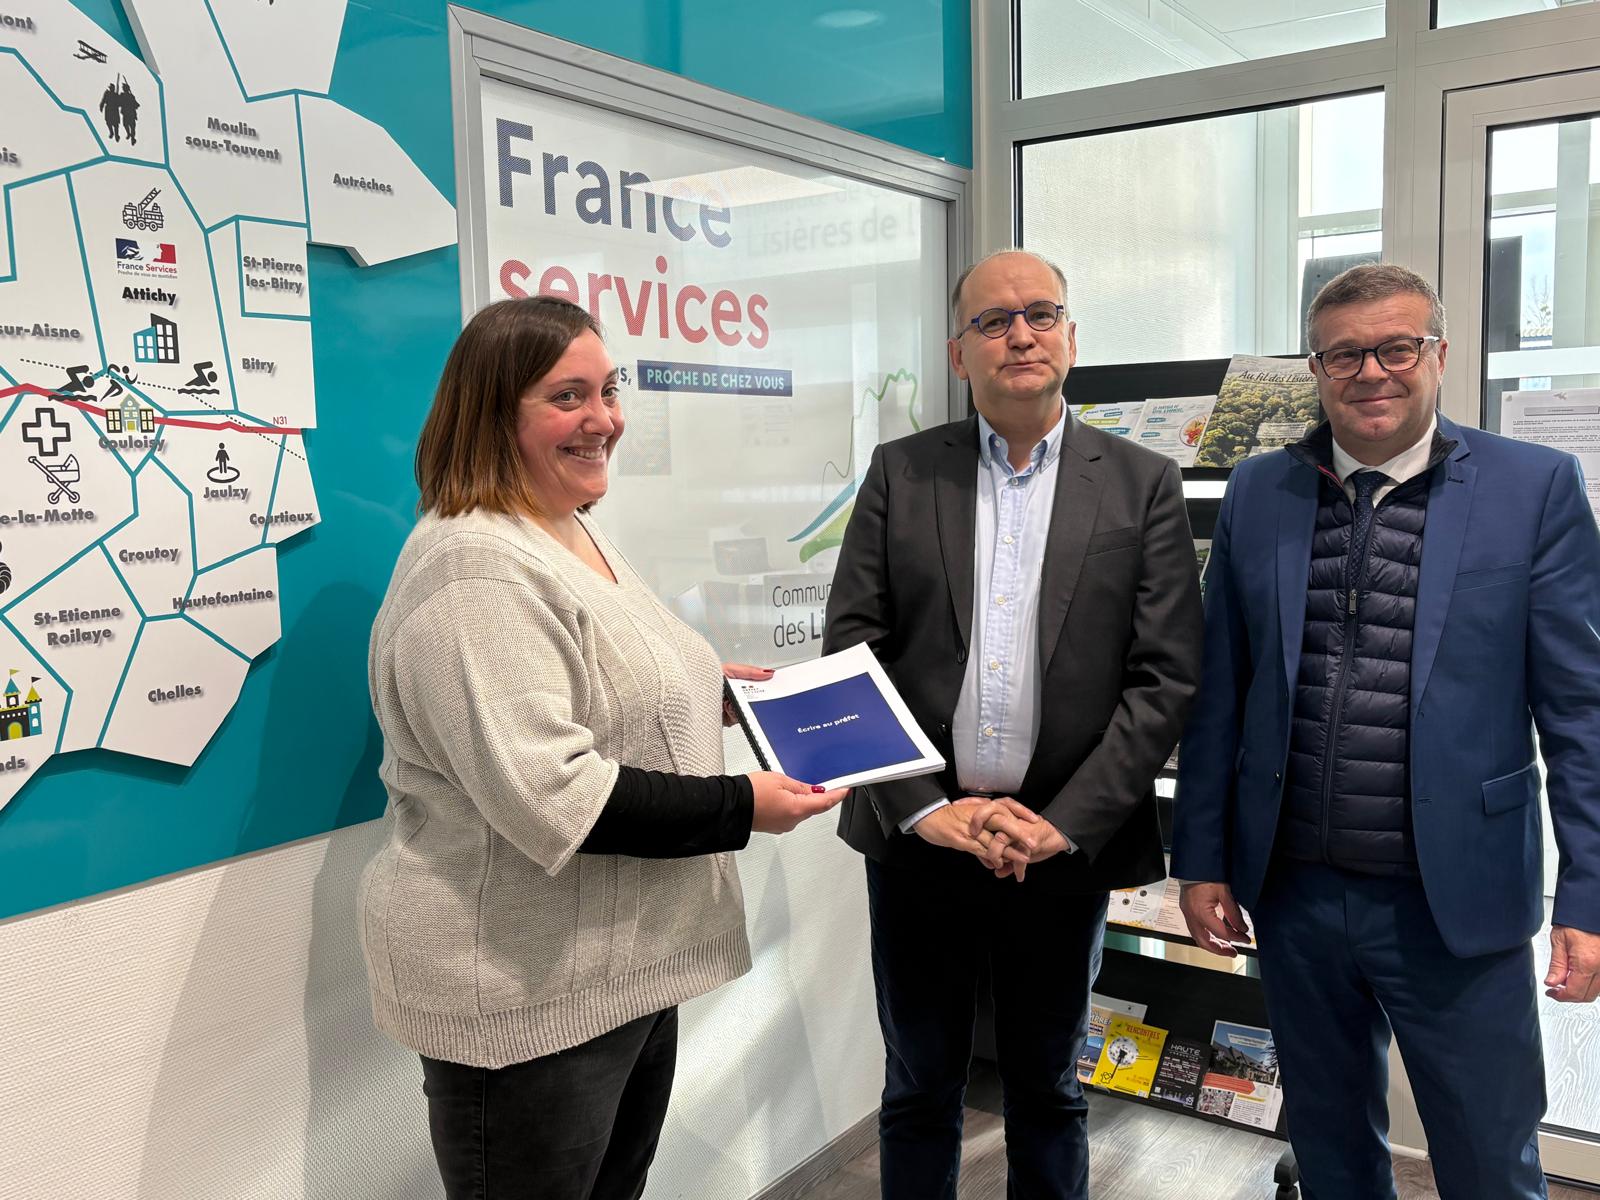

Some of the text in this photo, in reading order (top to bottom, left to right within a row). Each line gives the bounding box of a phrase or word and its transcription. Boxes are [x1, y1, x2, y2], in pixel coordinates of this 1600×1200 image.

[207, 117, 257, 137] Moulin
[185, 136, 279, 161] sous-Touvent
[333, 174, 392, 194] Autrêches
[496, 118, 732, 248] France
[117, 261, 177, 273] France Services
[243, 256, 303, 273] St-Pierre
[246, 275, 303, 294] les-Bitry
[122, 287, 176, 306] Attichy
[500, 255, 769, 349] services
[242, 358, 274, 374] Bitry
[647, 369, 784, 390] PROCHE DE CHEZ VOUS
[273, 416, 287, 425] N31
[99, 436, 165, 452] Couloisy
[204, 486, 248, 502] Jaulzy
[250, 511, 313, 526] Courtieux
[119, 548, 178, 563] Croutoy
[172, 589, 273, 609] Hautefontaine
[34, 606, 120, 627] St-Etienne
[47, 629, 111, 647] Roilaye
[774, 614, 805, 647] des
[148, 684, 201, 704] Chelles
